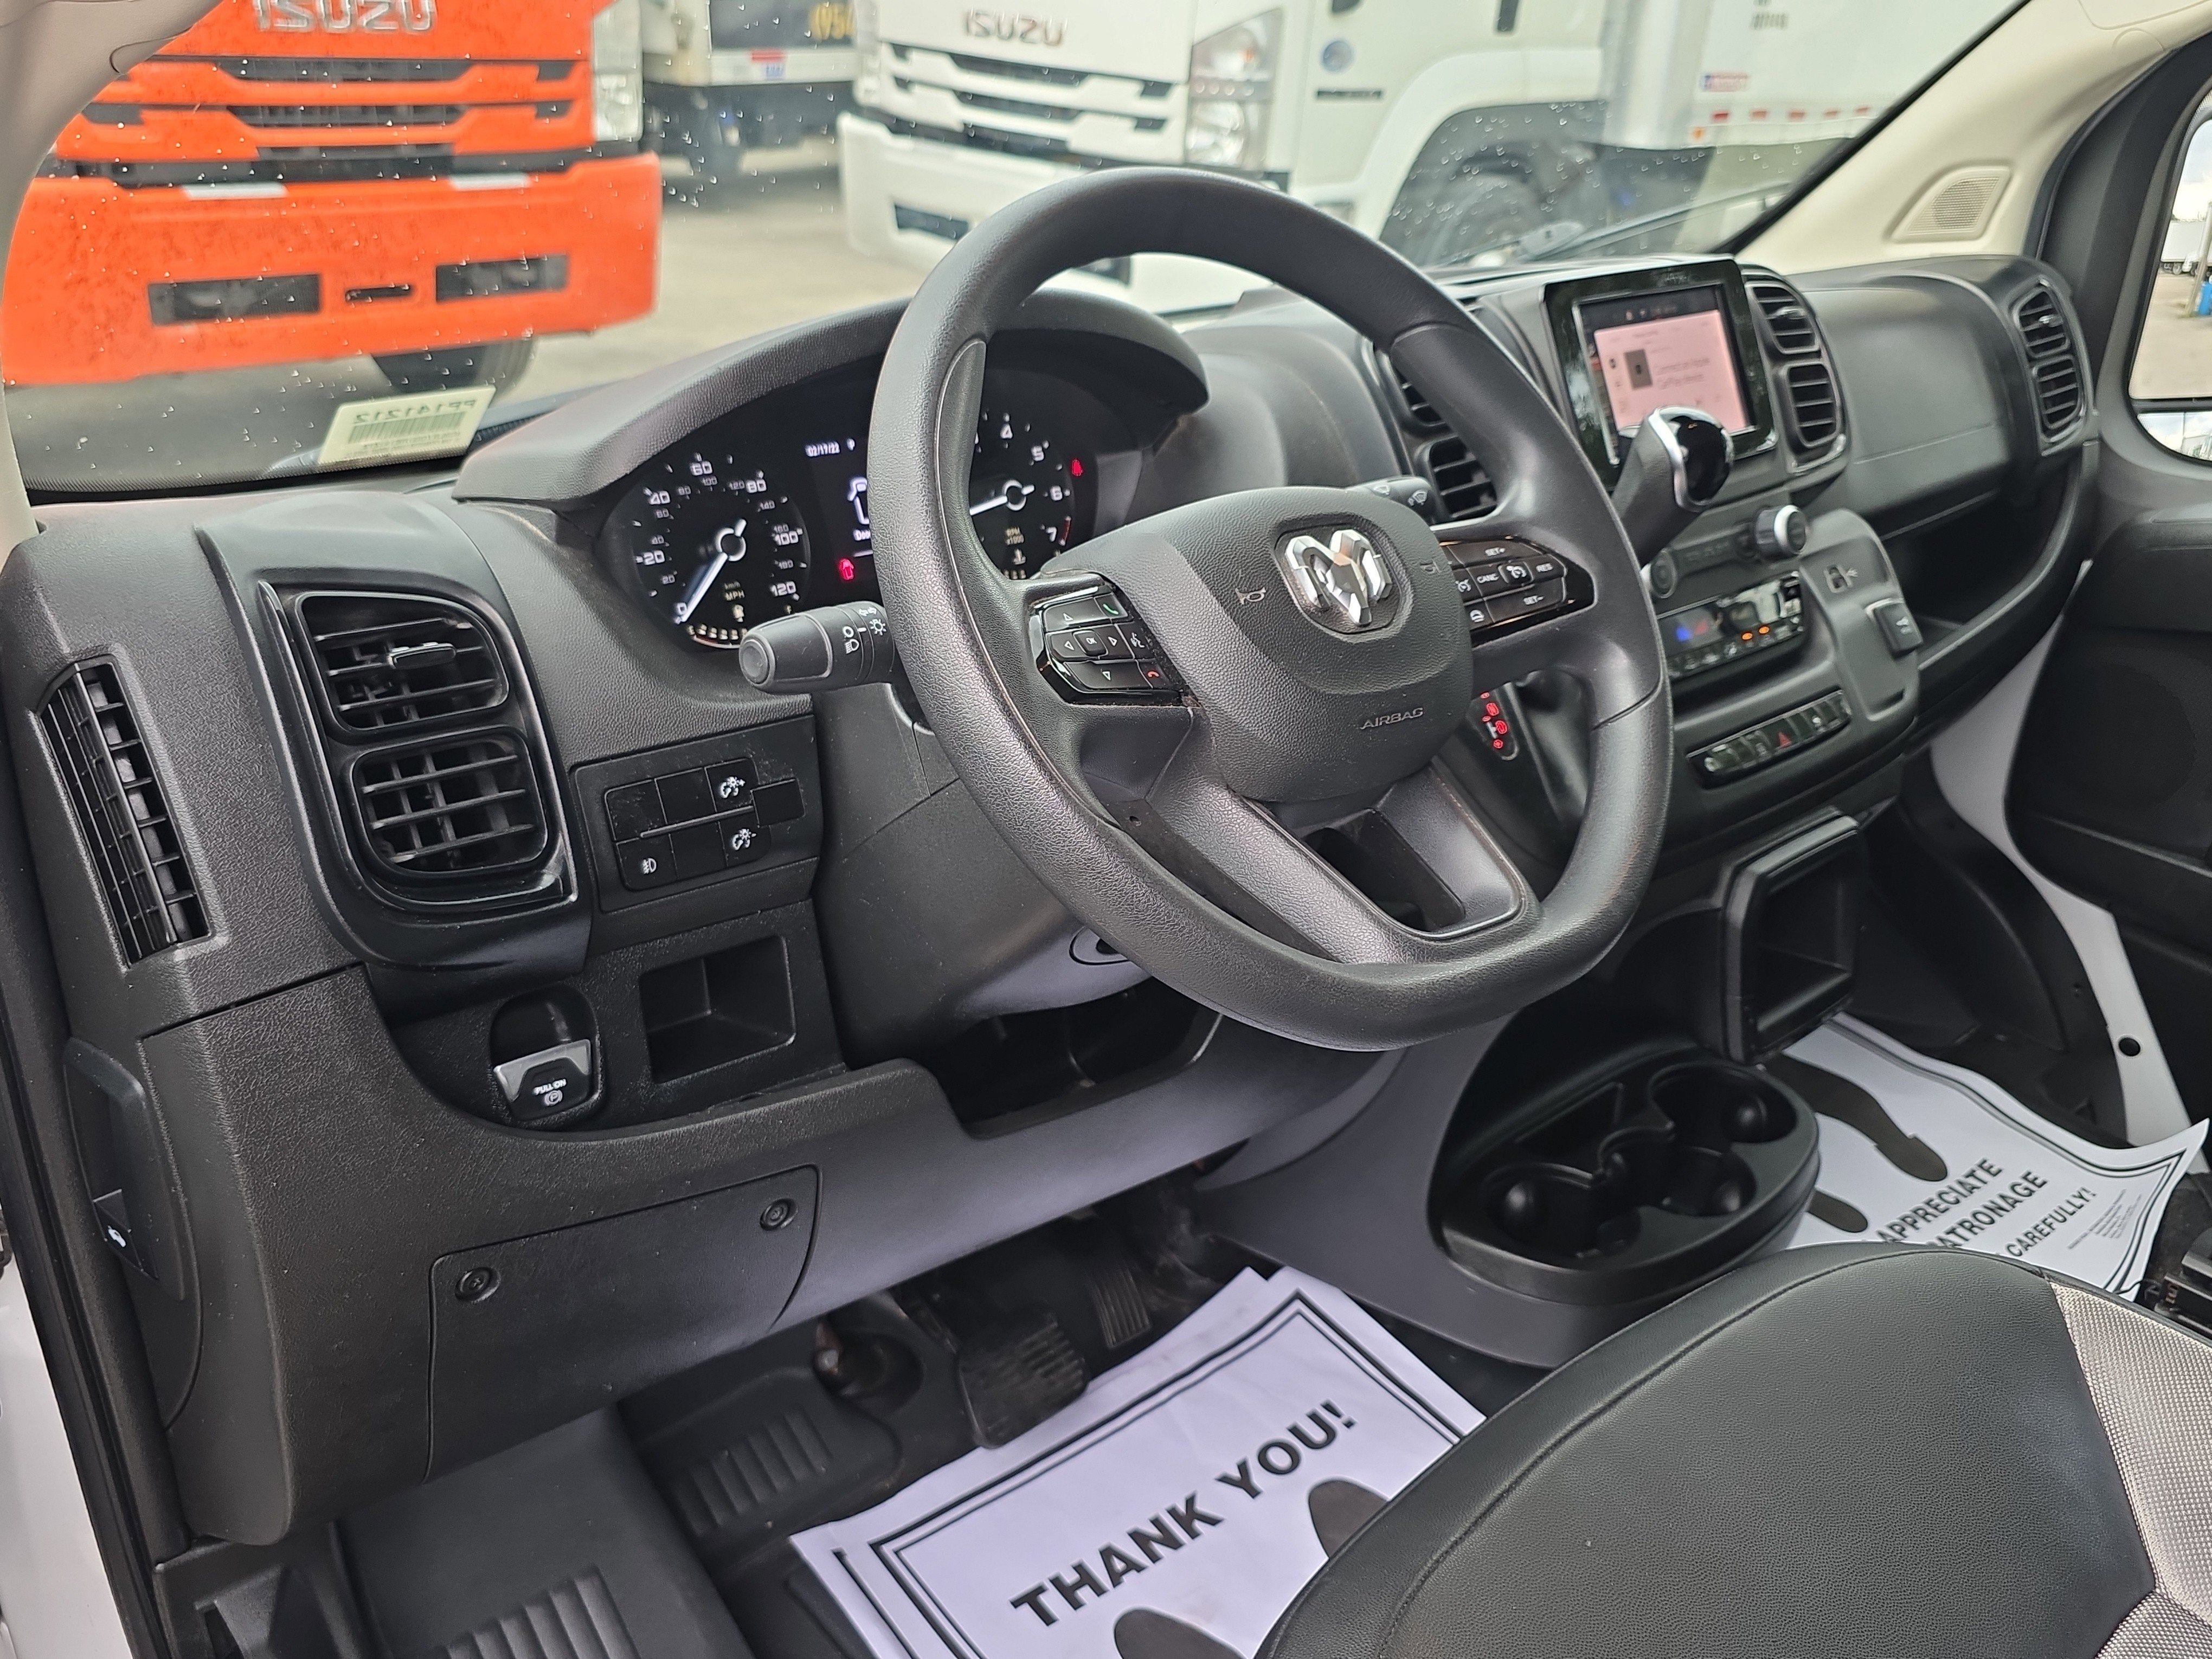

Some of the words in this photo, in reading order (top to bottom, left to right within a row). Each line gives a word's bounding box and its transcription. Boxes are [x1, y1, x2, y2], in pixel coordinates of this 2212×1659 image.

[253, 0, 437, 35] ISUZU
[965, 10, 1065, 46] ISUZU
[1000, 423, 1013, 439] 4
[1031, 445, 1044, 461] 5
[690, 461, 712, 475] 60
[746, 479, 767, 493] 80
[650, 491, 671, 505] 40
[775, 531, 799, 545] 100
[1046, 526, 1057, 542] 7
[644, 550, 665, 565] 20
[770, 581, 796, 596] 120
[1086, 637, 1097, 645] OK
[1360, 708, 1424, 730] AIRBAG
[533, 1083, 554, 1095] PULL
[552, 1079, 567, 1090] ON
[1876, 1158, 2003, 1243] APPRECIATE
[1926, 1169, 2049, 1248] ATRONAGE
[2005, 1186, 2097, 1258] CAREFULLY!
[1011, 1491, 1224, 1627] THANK
[1217, 1400, 1358, 1501] YOU!
